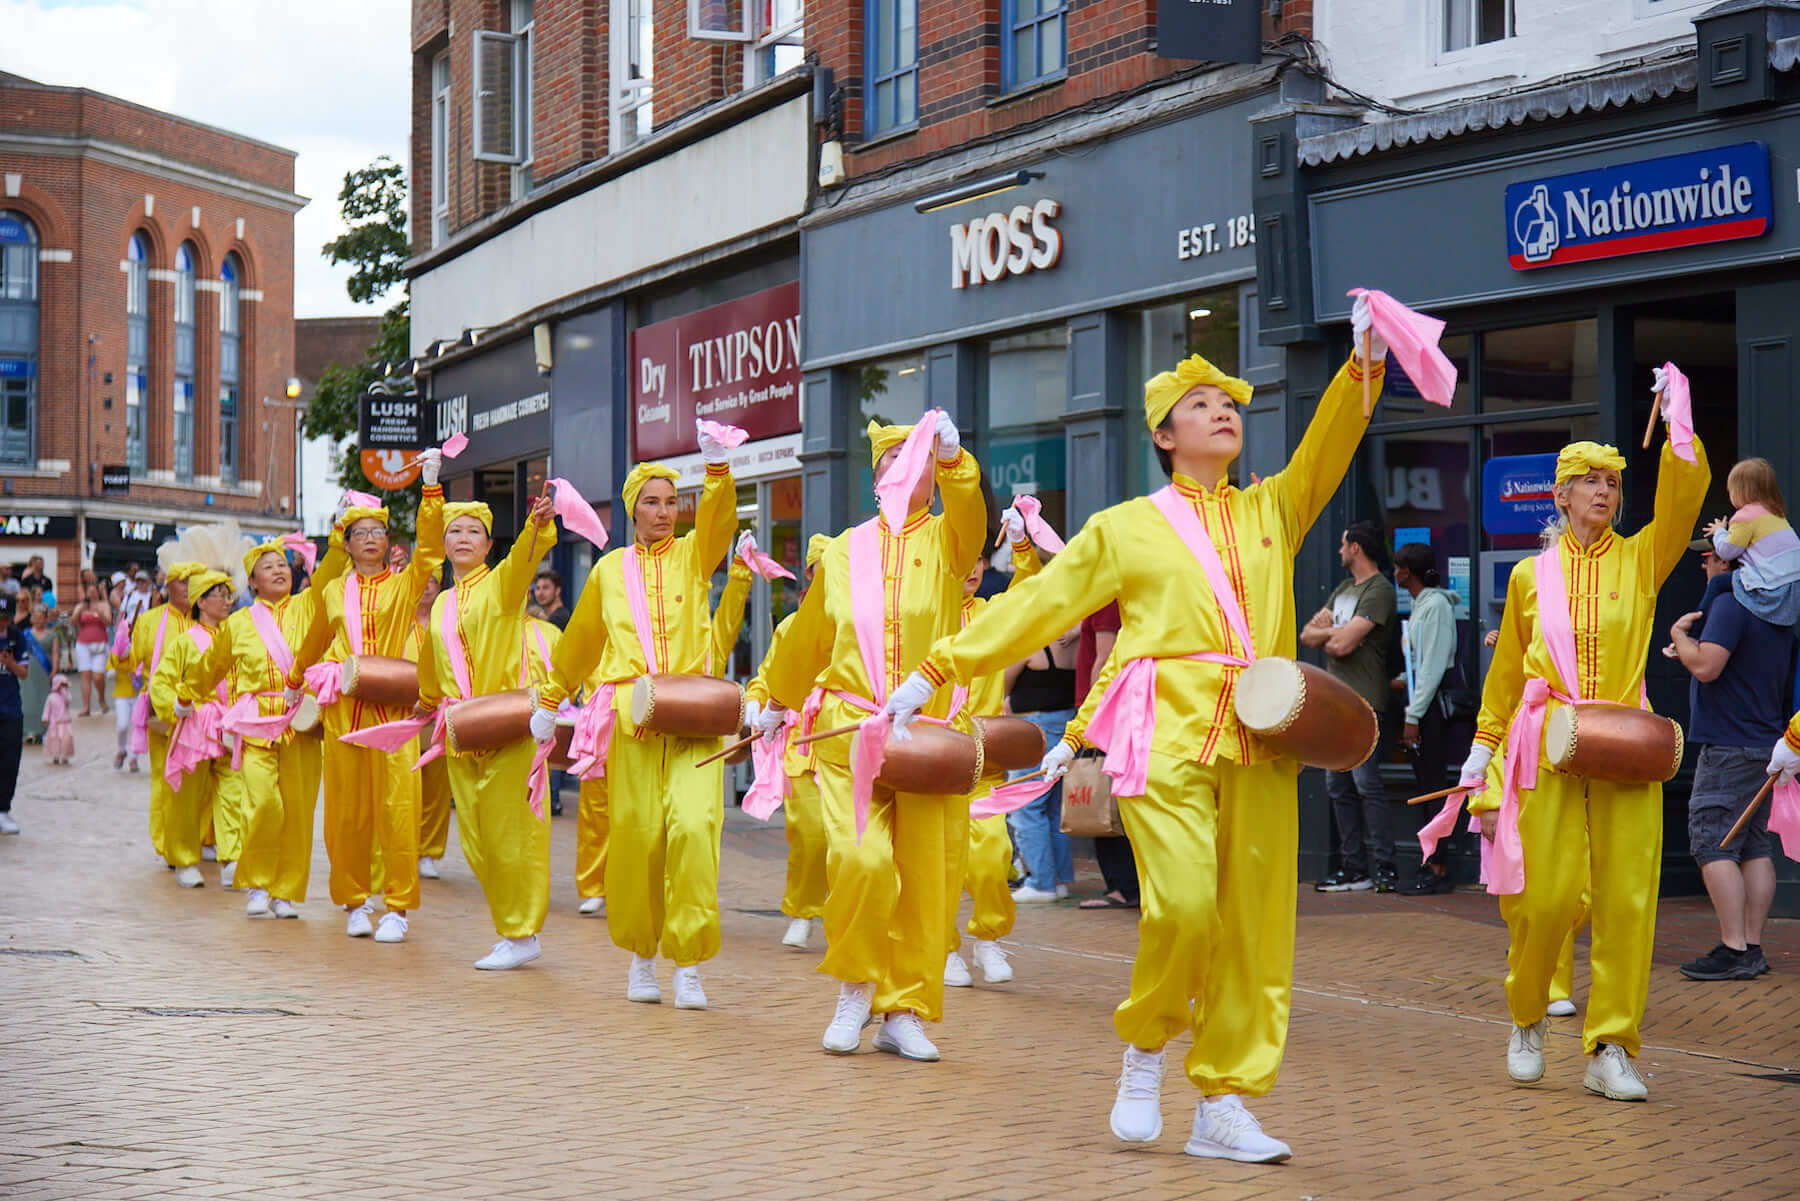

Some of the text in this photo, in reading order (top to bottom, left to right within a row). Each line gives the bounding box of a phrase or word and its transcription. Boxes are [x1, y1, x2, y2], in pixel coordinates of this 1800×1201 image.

[1563, 164, 1753, 239] Nationwide
[950, 199, 1061, 289] MOSS
[1178, 222, 1220, 260] EST.
[688, 314, 801, 393] TIMPSON
[641, 357, 667, 405] Dry
[695, 380, 794, 416] Great Service By Great People
[371, 401, 417, 417] LUSH
[436, 394, 469, 441] LUSH
[638, 402, 671, 424] Cleaning
[369, 434, 418, 442] COSMETICS
[0, 515, 49, 536] AST
[119, 520, 155, 542] TOAST
